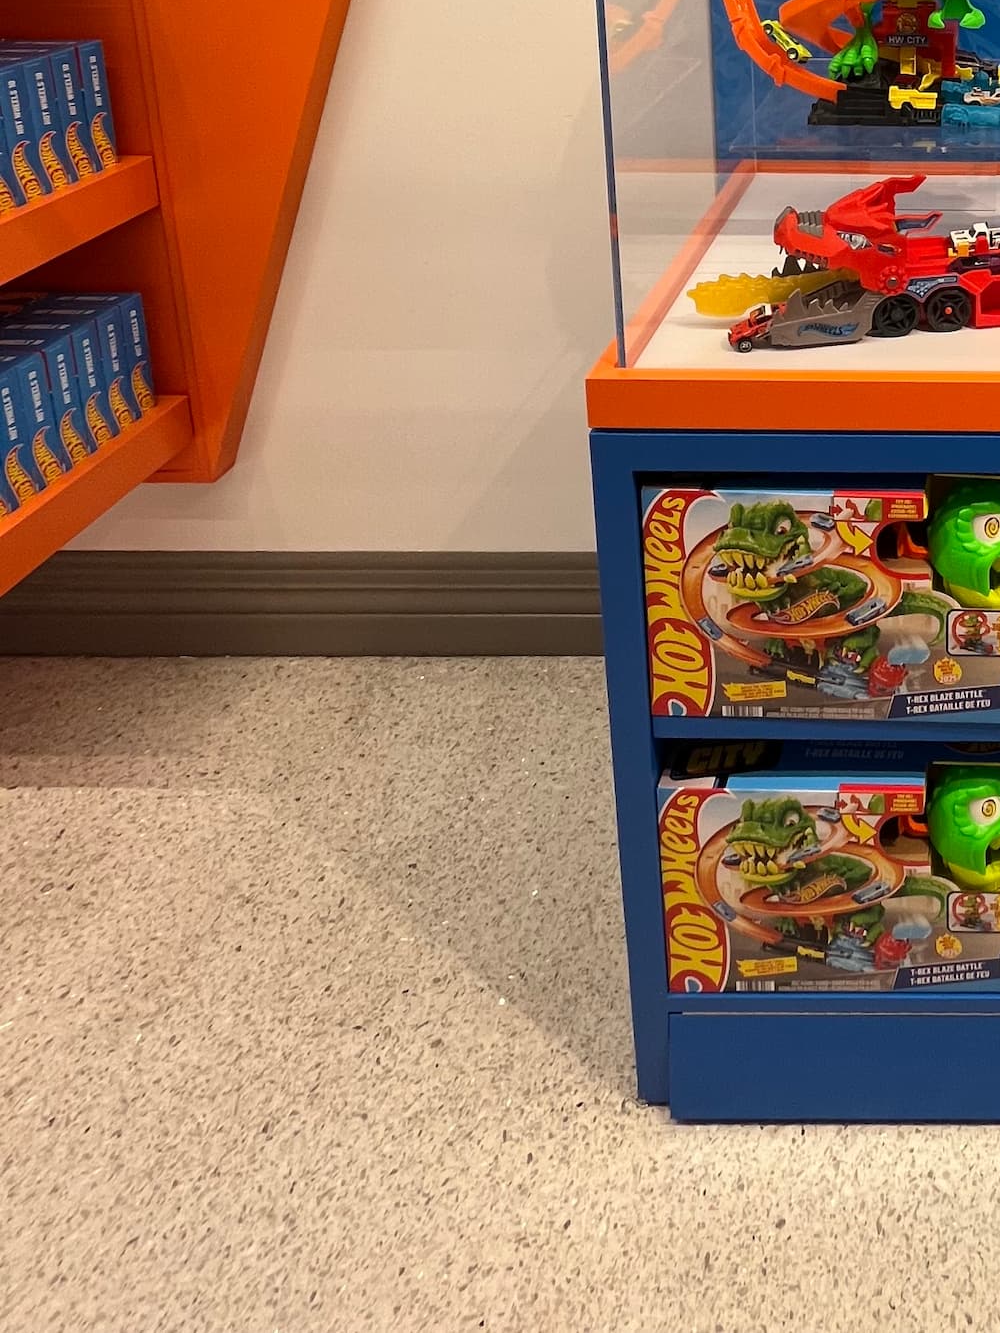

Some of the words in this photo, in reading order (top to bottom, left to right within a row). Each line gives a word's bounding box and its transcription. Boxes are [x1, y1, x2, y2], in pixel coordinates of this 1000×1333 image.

[888, 36, 904, 44] HW
[906, 36, 926, 44] CITY
[954, 690, 983, 700] BATTLE
[965, 701, 975, 709] DE
